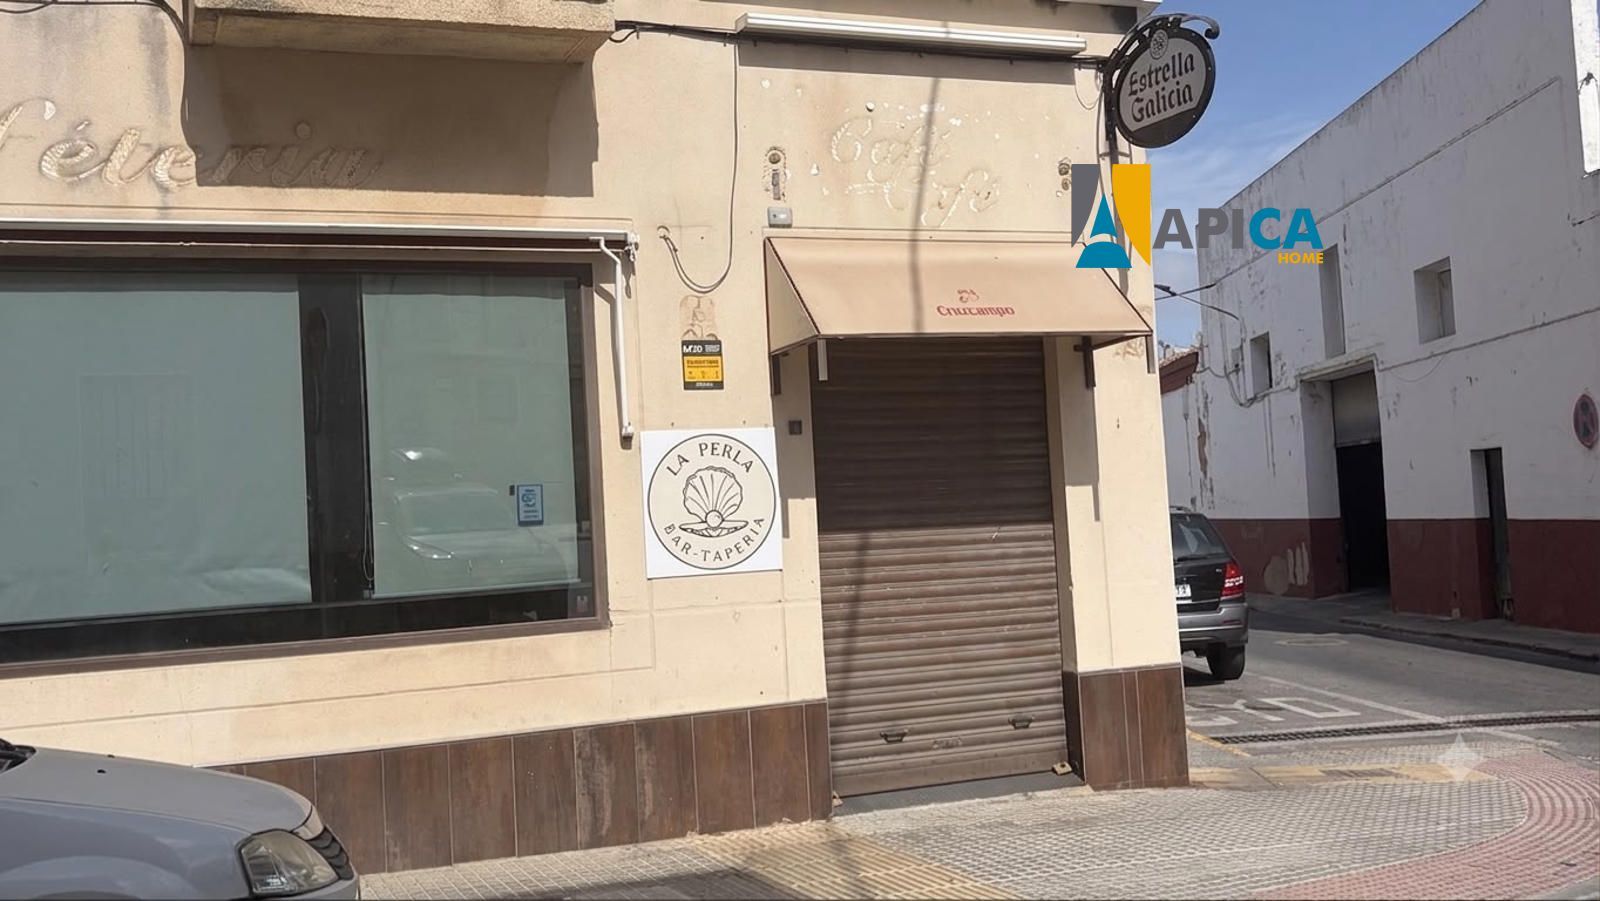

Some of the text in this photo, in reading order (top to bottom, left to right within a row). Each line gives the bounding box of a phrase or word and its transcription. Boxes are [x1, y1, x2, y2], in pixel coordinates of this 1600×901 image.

[1128, 52, 1195, 97] Estrella
[1131, 80, 1194, 123] Galicia
[666, 442, 754, 476] LA PERLA
